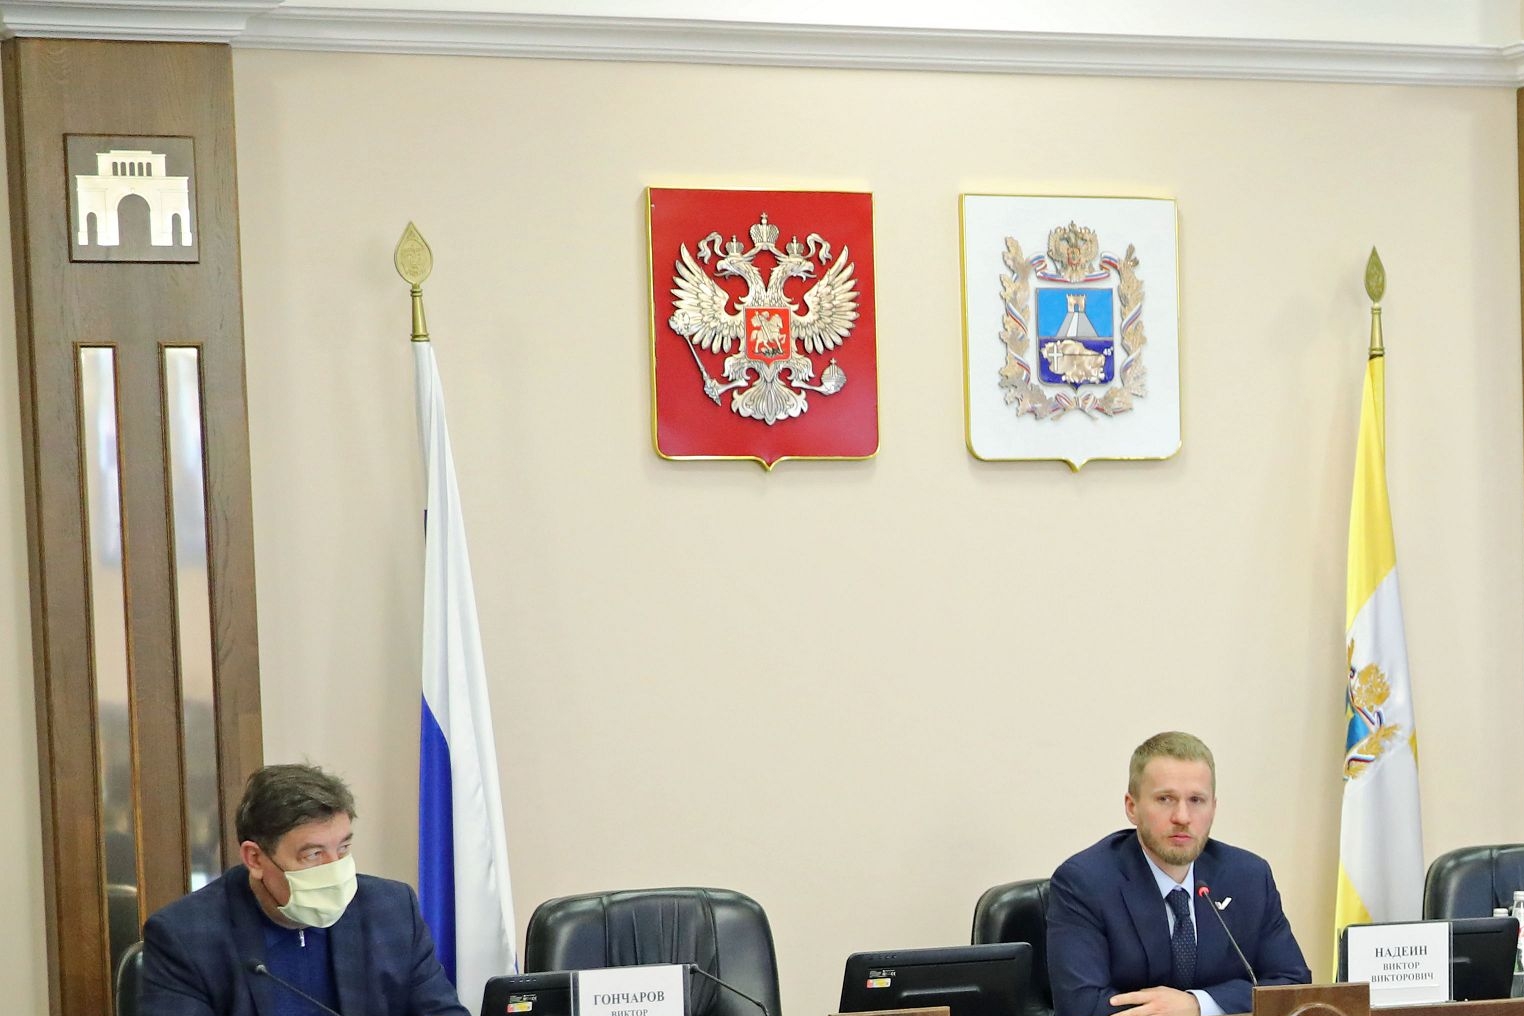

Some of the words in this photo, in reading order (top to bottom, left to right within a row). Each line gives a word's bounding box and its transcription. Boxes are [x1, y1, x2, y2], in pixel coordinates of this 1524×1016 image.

[1375, 945, 1428, 958] НАДЕИН
[1383, 961, 1420, 971] ВИКТОР
[1371, 972, 1434, 983] ВИКТОРОВИЧ
[593, 991, 665, 1006] ГОНЧАРОВ
